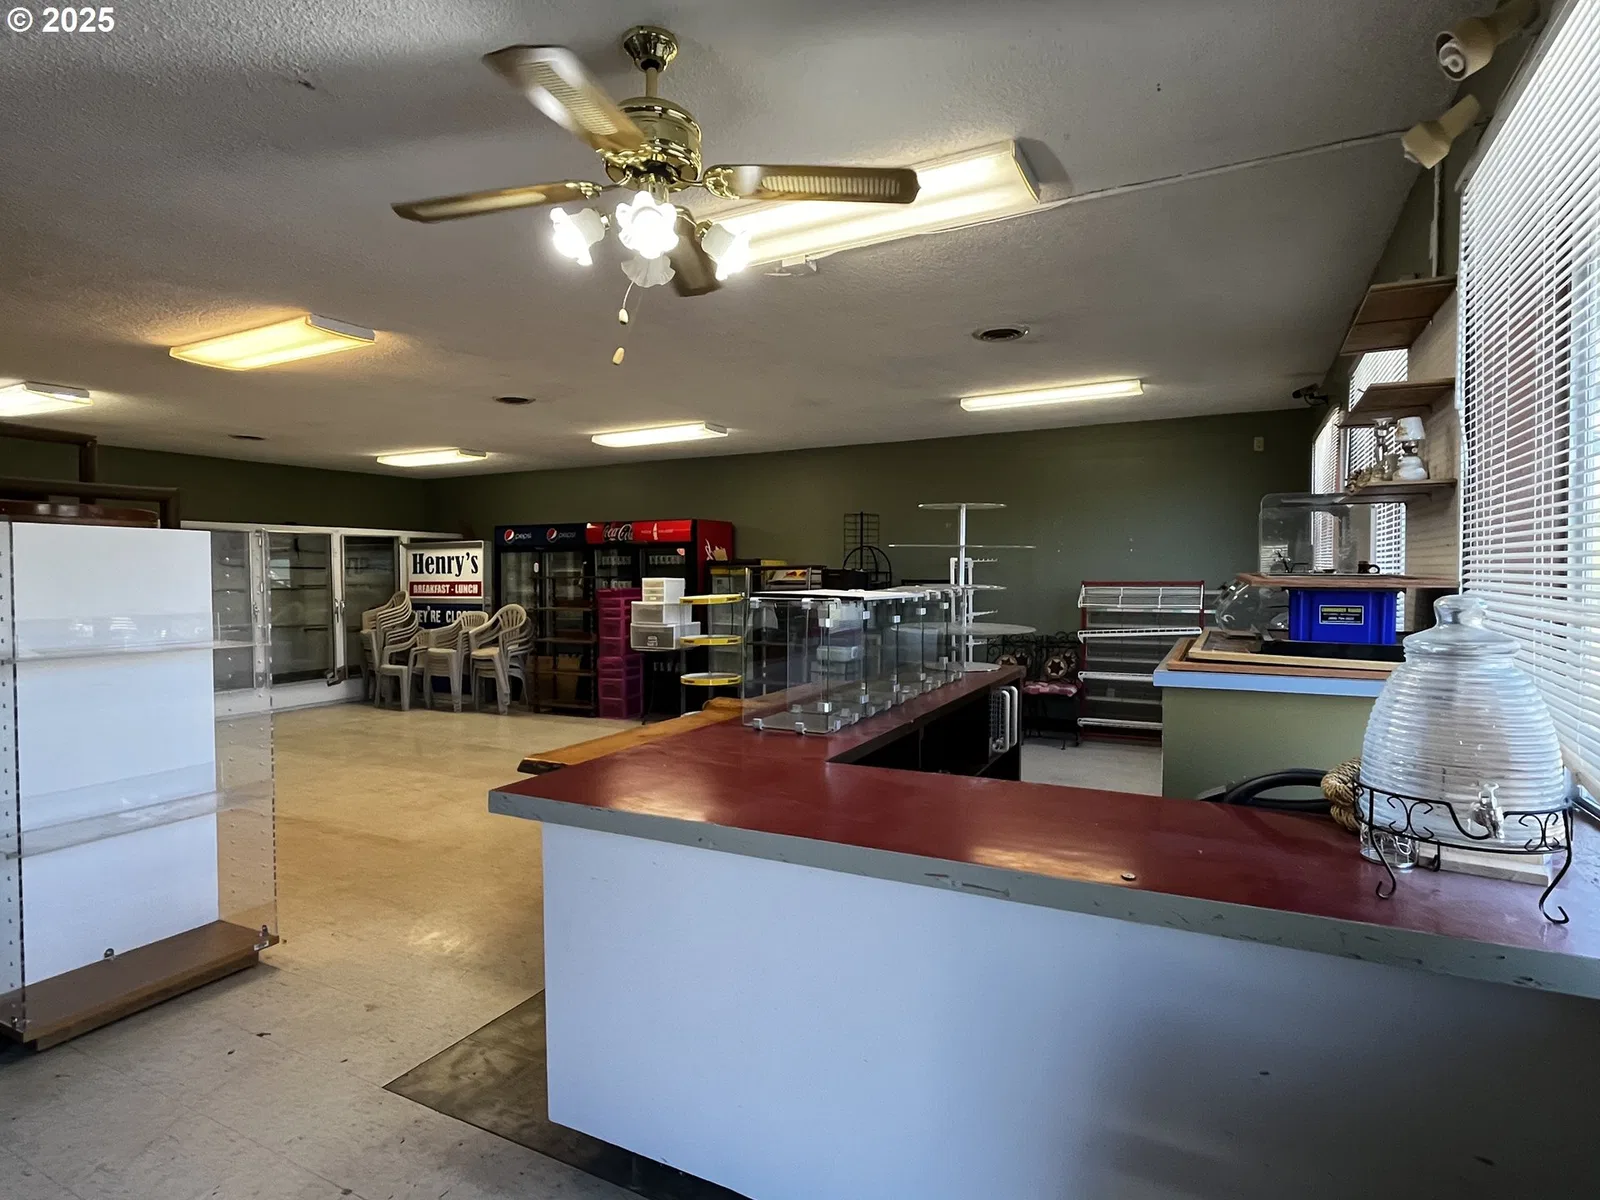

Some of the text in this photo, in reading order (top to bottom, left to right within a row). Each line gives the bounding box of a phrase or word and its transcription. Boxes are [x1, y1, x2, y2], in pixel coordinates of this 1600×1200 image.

[412, 551, 479, 577] Henry's
[413, 584, 450, 594] BREAKFAST
[455, 584, 478, 594] LUNCH
